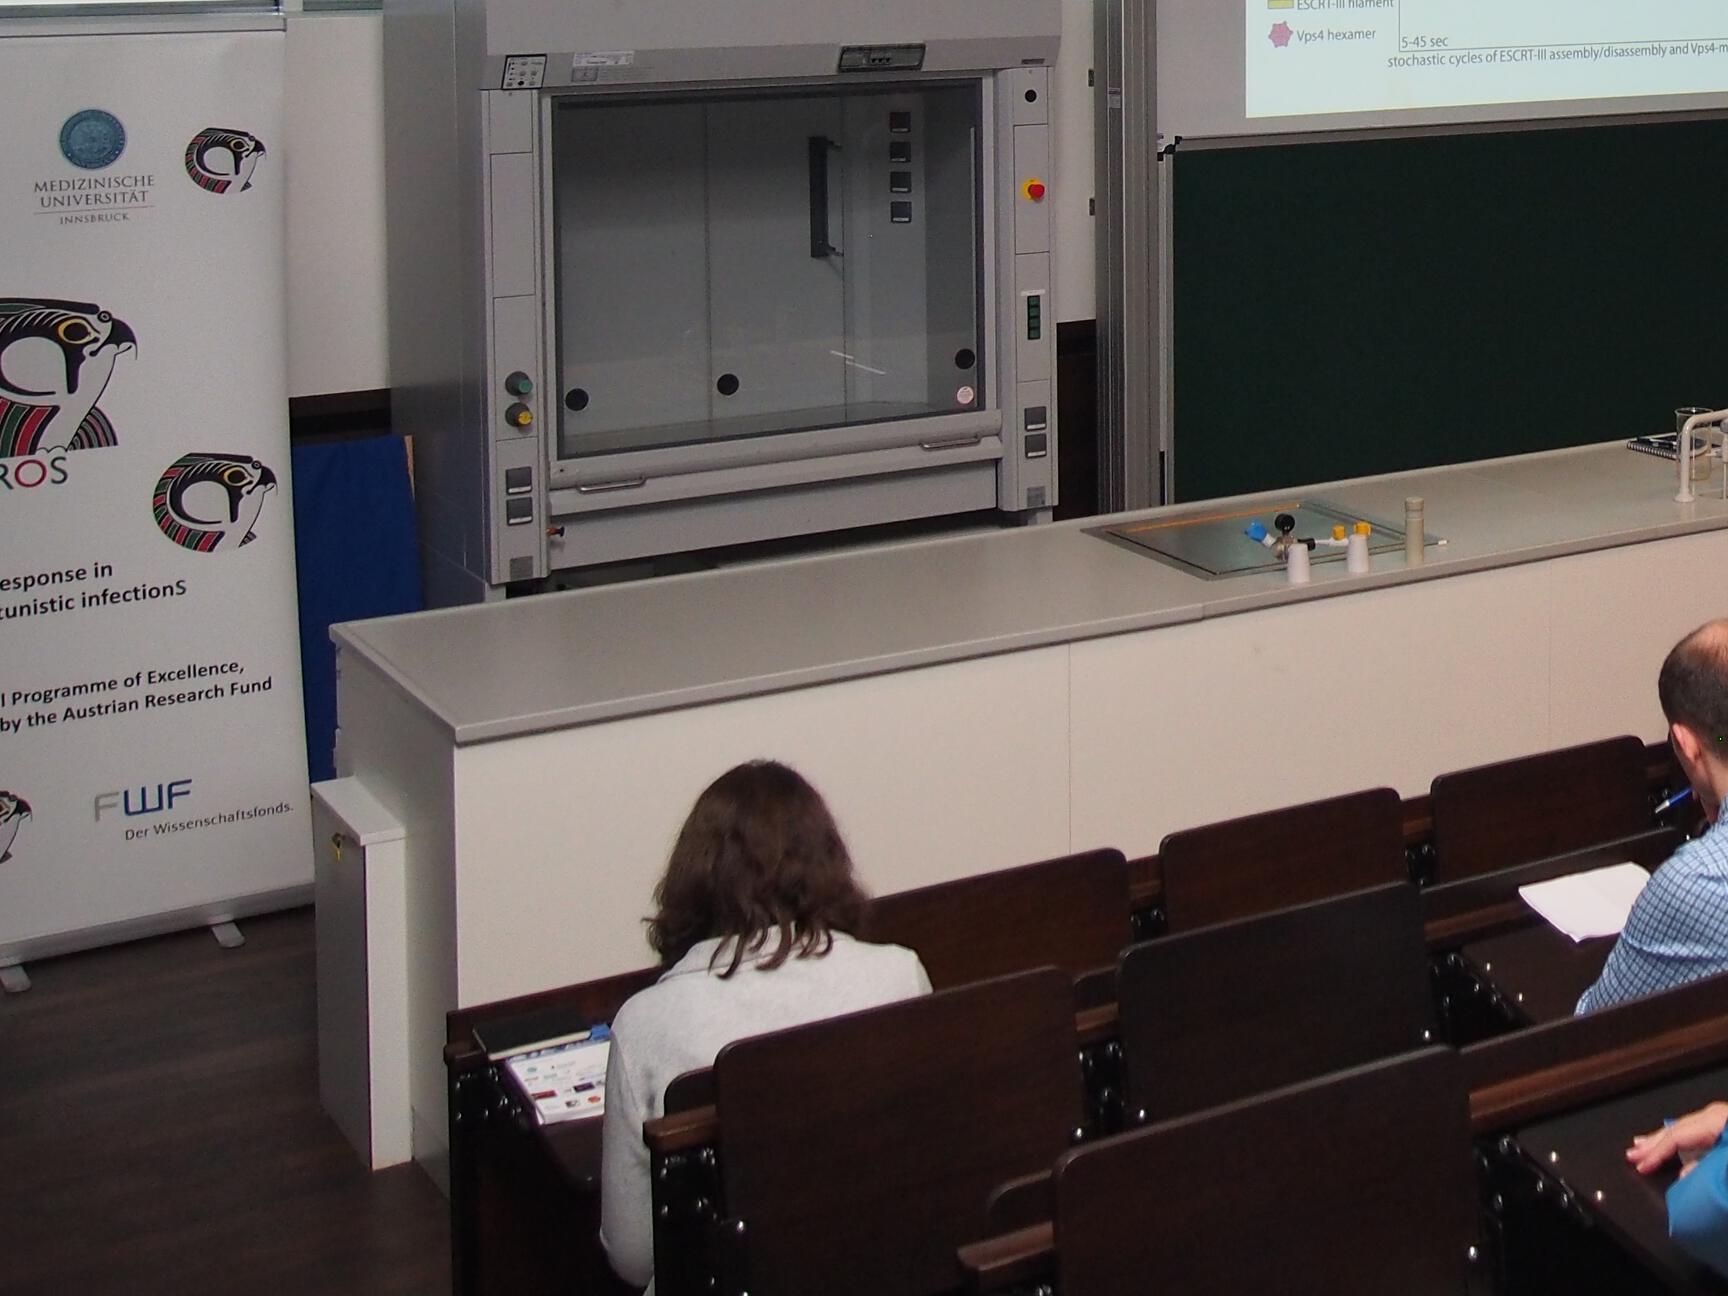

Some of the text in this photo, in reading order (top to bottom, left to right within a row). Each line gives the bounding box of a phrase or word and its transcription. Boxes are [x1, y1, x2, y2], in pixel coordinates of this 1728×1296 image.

[1297, 28, 1376, 45] Vps4 hexamer
[1402, 35, 1448, 50] 5-45 sec
[1387, 52, 1446, 68] stochastic
[1448, 51, 1483, 68] cycles
[1485, 49, 1498, 63] of
[1499, 48, 1546, 62] ESCRT-III
[1549, 42, 1668, 62] assembly/disassembly
[1668, 42, 1689, 55] and
[34, 174, 154, 192] MEDIZINISCHE
[40, 189, 148, 208] UNIVERSITÄT
[60, 212, 130, 225] INNSBRUCK
[94, 562, 112, 579] in
[81, 579, 186, 608] infectionS
[12, 679, 118, 706] Programme
[123, 671, 142, 688] of
[147, 662, 244, 685] Excellence,
[0, 675, 272, 734] by the Austrian Research Fund
[94, 778, 193, 823] FWF
[125, 828, 148, 841] Der
